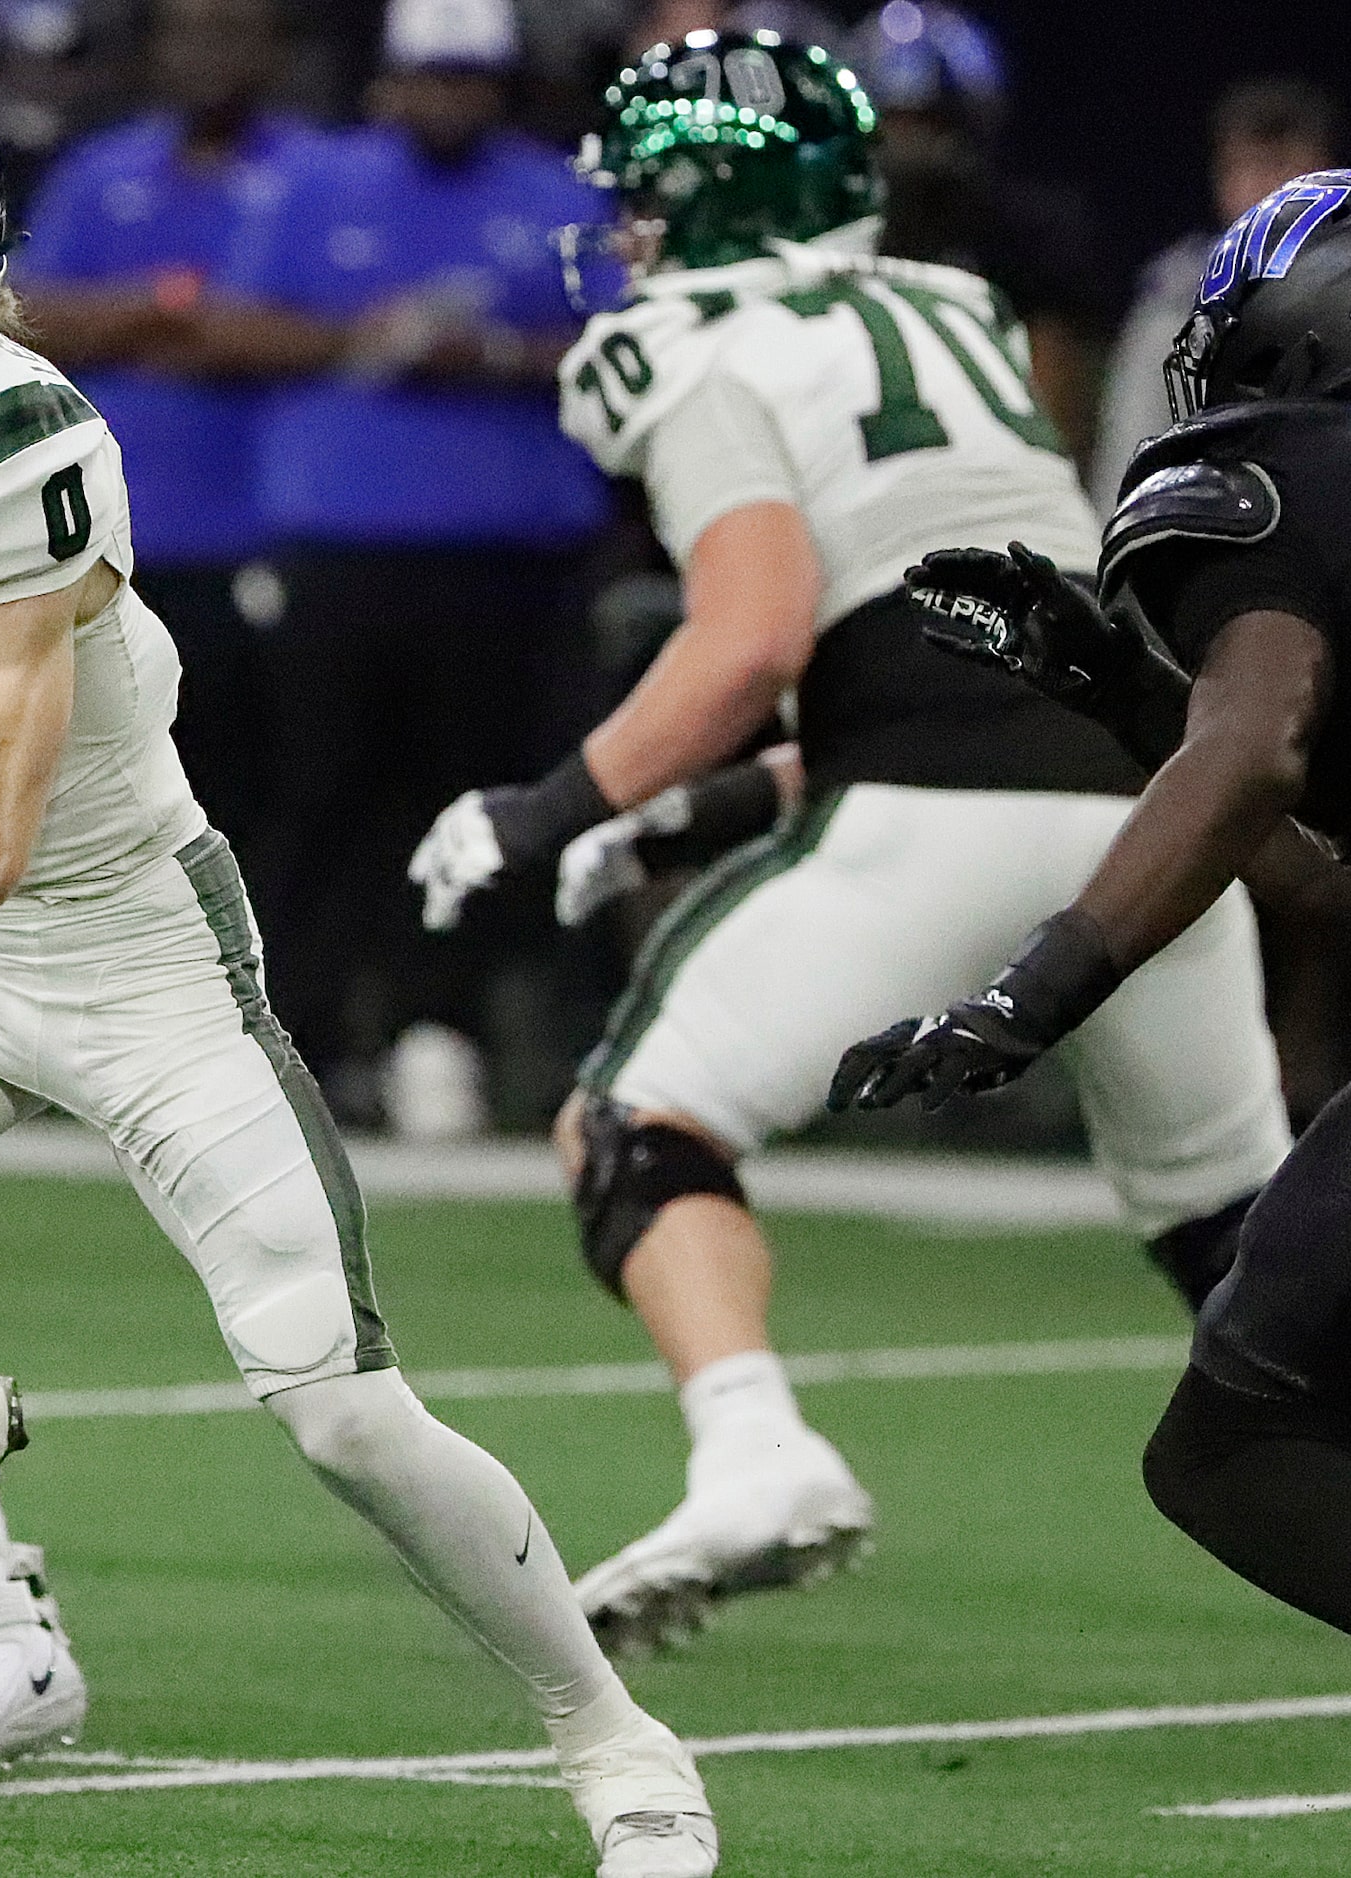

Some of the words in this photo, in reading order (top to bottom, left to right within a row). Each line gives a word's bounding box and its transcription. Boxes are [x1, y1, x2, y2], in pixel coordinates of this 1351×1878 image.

[575, 332, 652, 433] 70
[776, 268, 1068, 462] 70
[41, 462, 92, 562] 0
